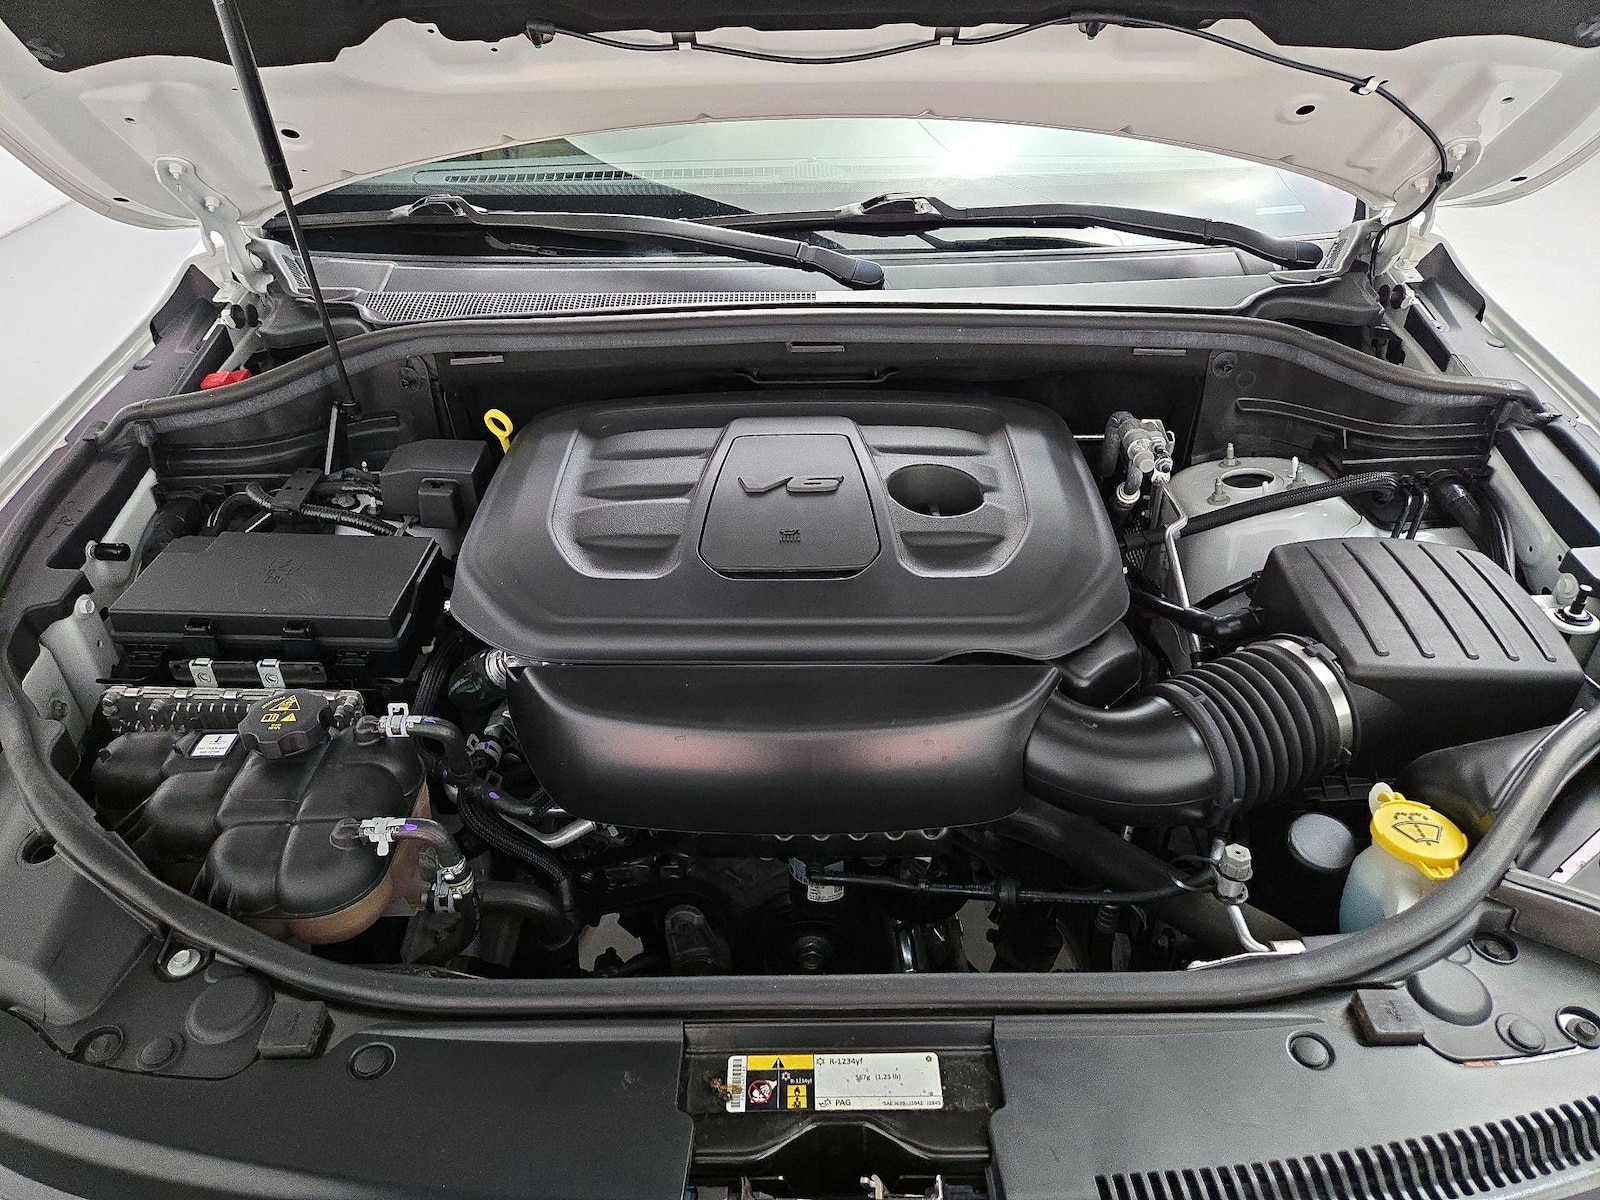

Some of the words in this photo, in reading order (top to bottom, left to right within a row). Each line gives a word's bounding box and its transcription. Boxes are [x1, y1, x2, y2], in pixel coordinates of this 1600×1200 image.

[829, 1057, 863, 1066] R-1234yf
[875, 1073, 891, 1081] (1.25
[892, 1073, 901, 1081] lb)
